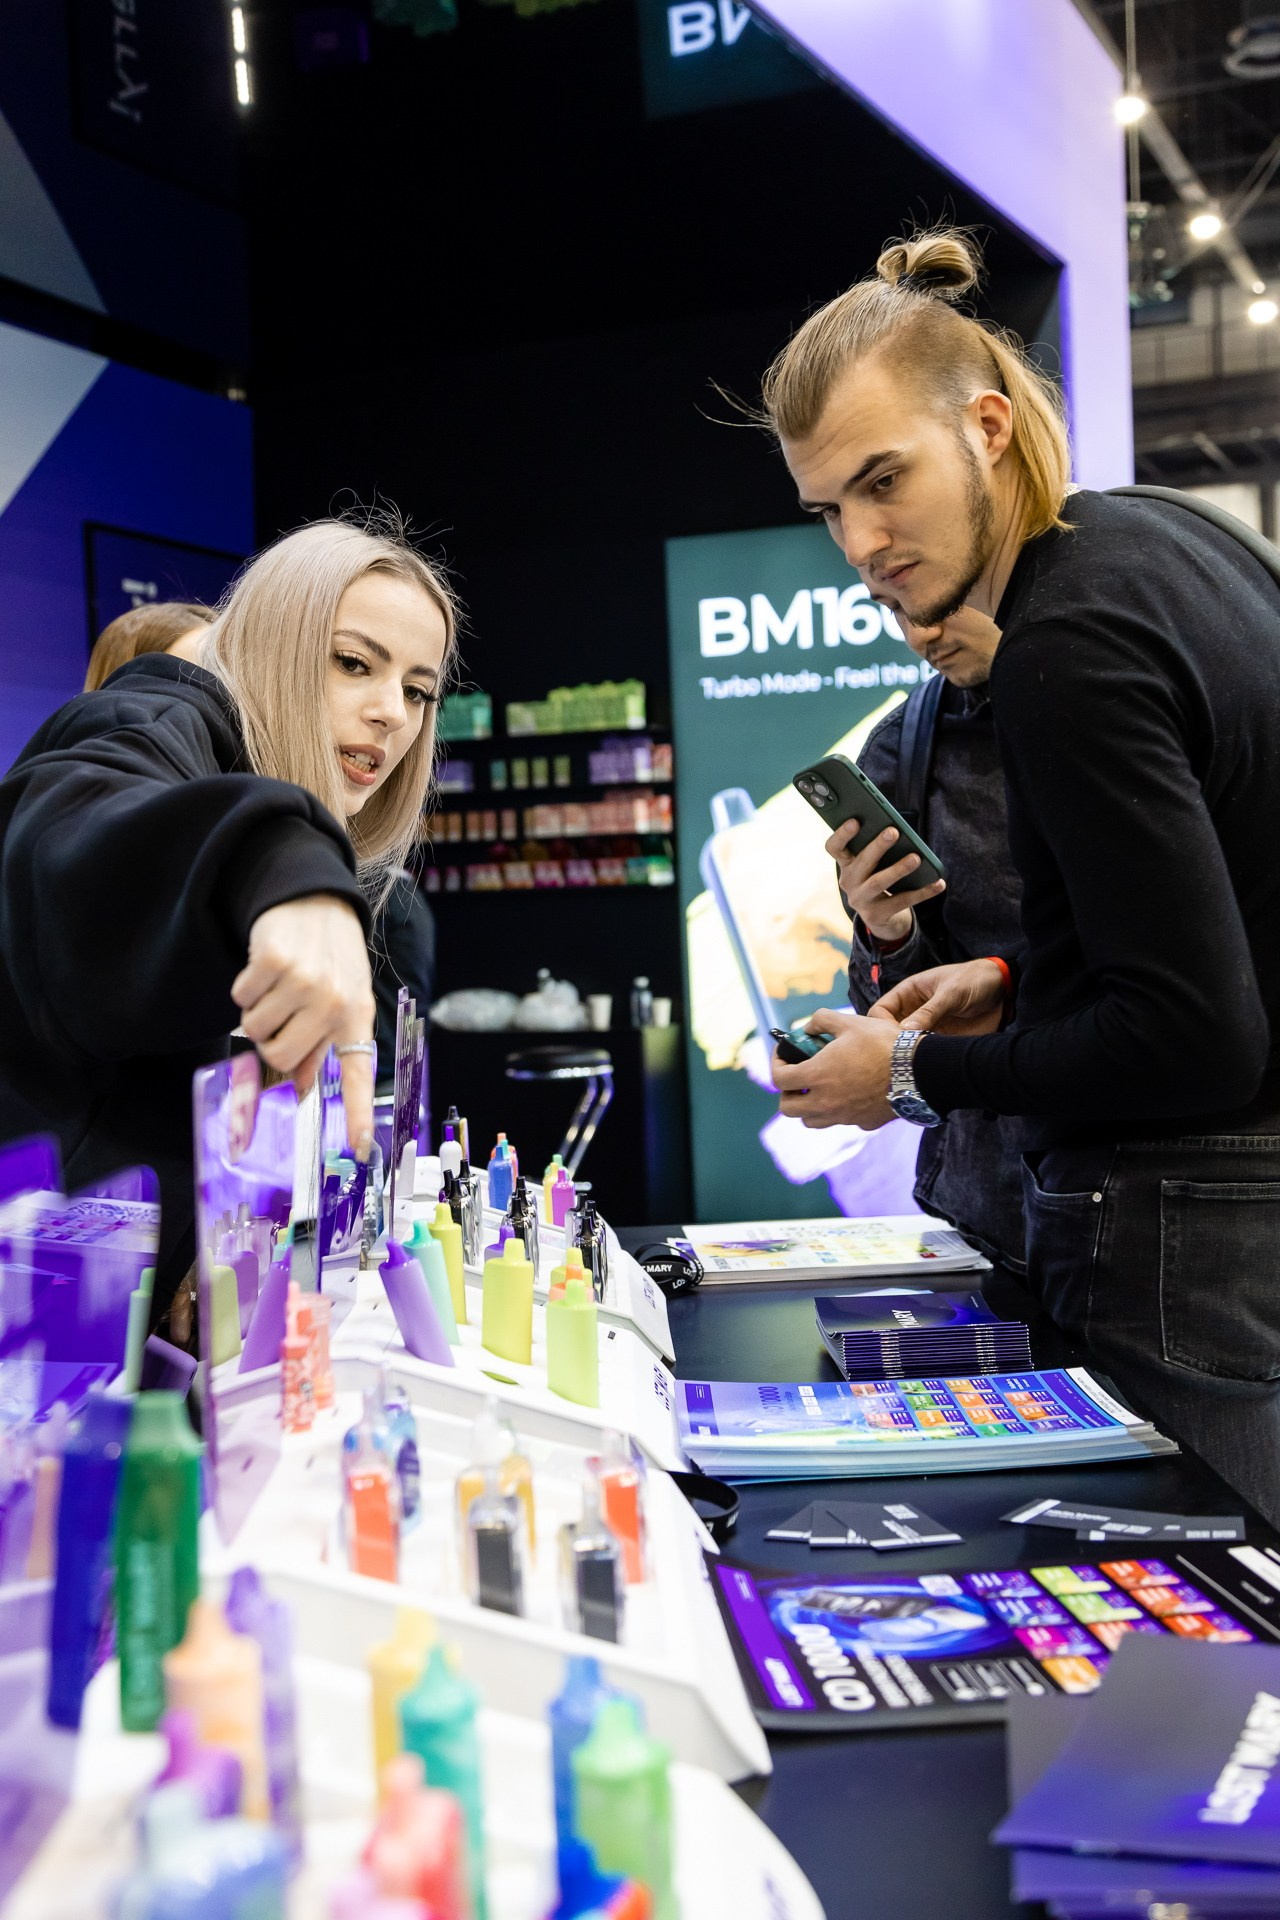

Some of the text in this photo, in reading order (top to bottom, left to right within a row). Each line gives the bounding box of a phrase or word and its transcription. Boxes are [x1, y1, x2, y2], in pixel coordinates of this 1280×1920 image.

[700, 674, 761, 700] Turbo
[761, 668, 822, 696] Mode
[834, 663, 880, 690] Feel
[880, 660, 920, 686] the
[646, 1264, 672, 1273] MARY
[672, 1278, 686, 1289] LOS
